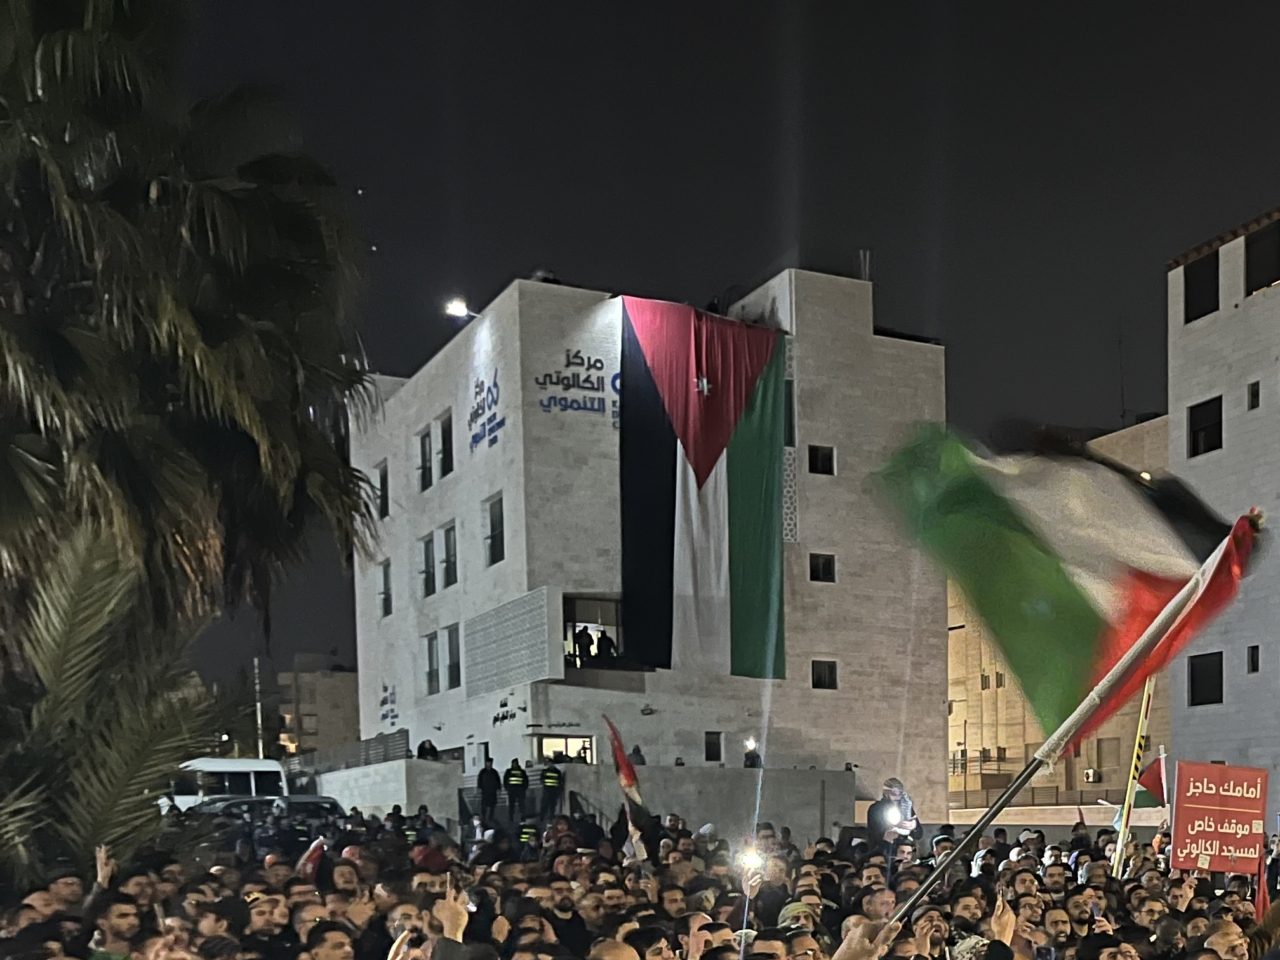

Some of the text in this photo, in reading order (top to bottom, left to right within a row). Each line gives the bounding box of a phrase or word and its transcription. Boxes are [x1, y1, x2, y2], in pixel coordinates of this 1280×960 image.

[564, 349, 604, 372] مركز
[535, 371, 605, 392] الكالوتي
[539, 395, 606, 415] التنموي
[1186, 777, 1261, 799] أمامك حاجز
[1187, 816, 1250, 838] موقف خاص
[1177, 839, 1260, 862] لمسجد الكالوتي
